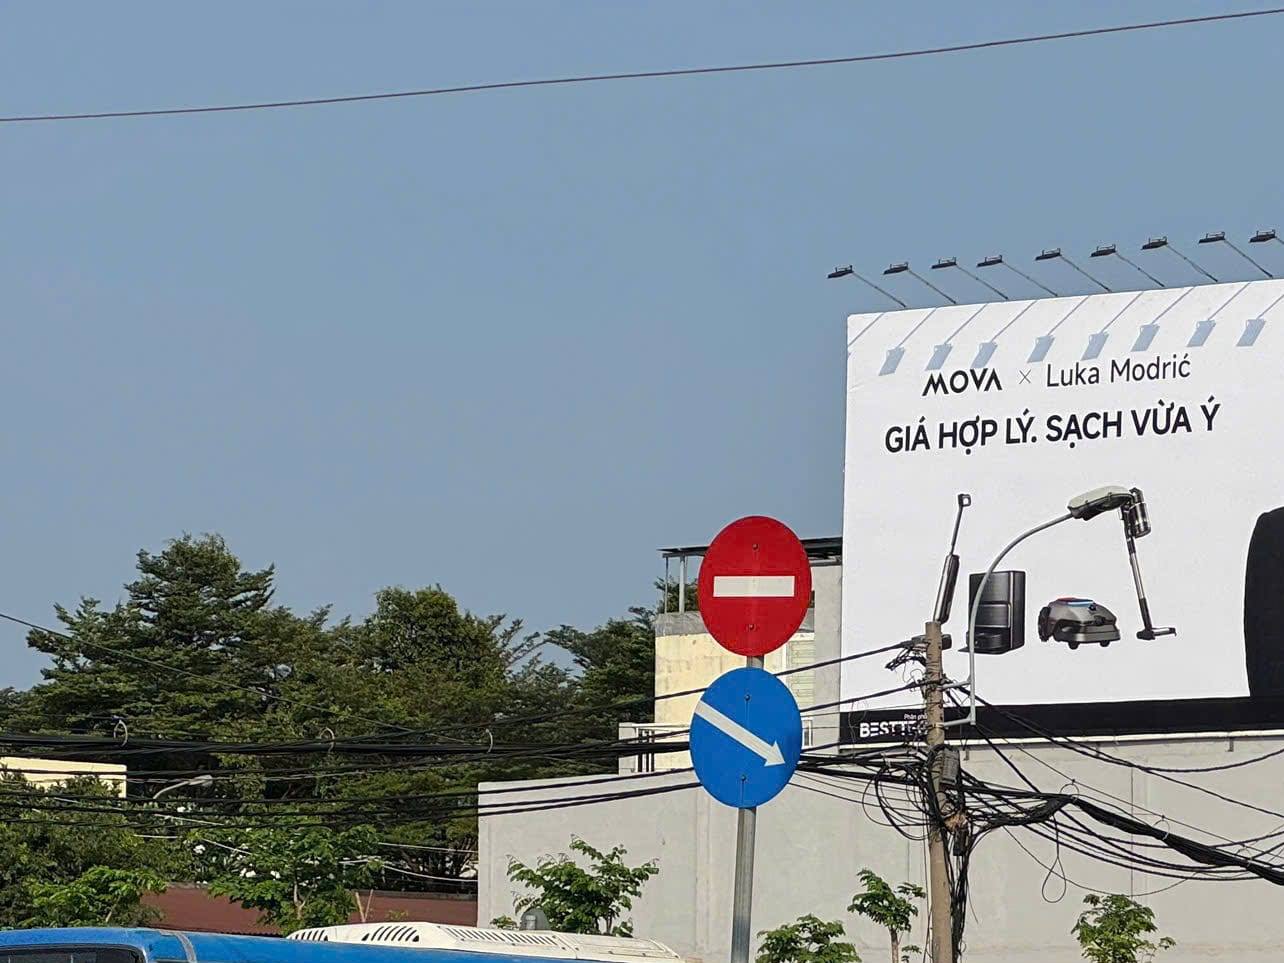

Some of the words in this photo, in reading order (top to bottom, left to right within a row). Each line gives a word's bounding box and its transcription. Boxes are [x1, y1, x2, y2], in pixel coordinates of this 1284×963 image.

[922, 367, 1003, 397] MOVA
[1046, 363, 1101, 387] Luka
[1110, 353, 1191, 383] Modrić
[885, 415, 931, 453] GIÁ
[938, 414, 999, 456] HỢP
[1005, 408, 1038, 445] LÝ.
[1046, 410, 1123, 449] SẠCH
[1131, 399, 1192, 436] VỪA
[1199, 395, 1221, 431] Ý
